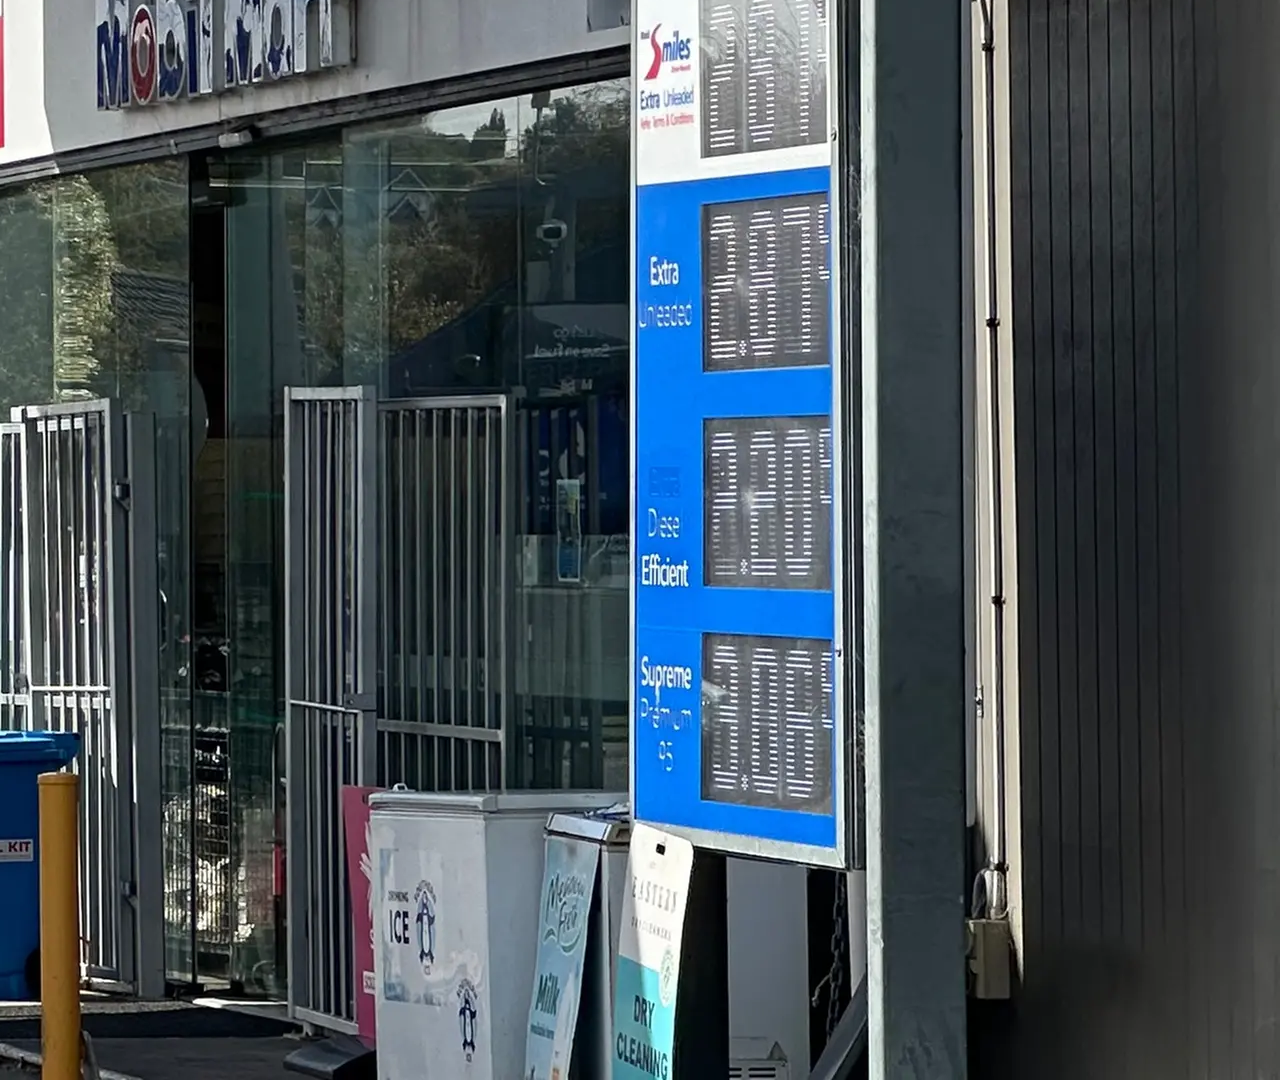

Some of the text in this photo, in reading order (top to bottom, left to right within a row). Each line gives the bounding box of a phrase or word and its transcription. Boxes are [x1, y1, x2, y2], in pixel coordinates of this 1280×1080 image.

[644, 23, 691, 80] Smiles
[640, 85, 695, 110] Extra Unleaded
[650, 256, 679, 286] Extra
[641, 553, 689, 587] Efficient
[640, 655, 692, 692] Supreme
[8, 841, 32, 853] KIT
[389, 909, 410, 945] ICE
[535, 972, 561, 1016] Milk
[633, 994, 656, 1034] DRY
[616, 1031, 669, 1080] CLEANING
